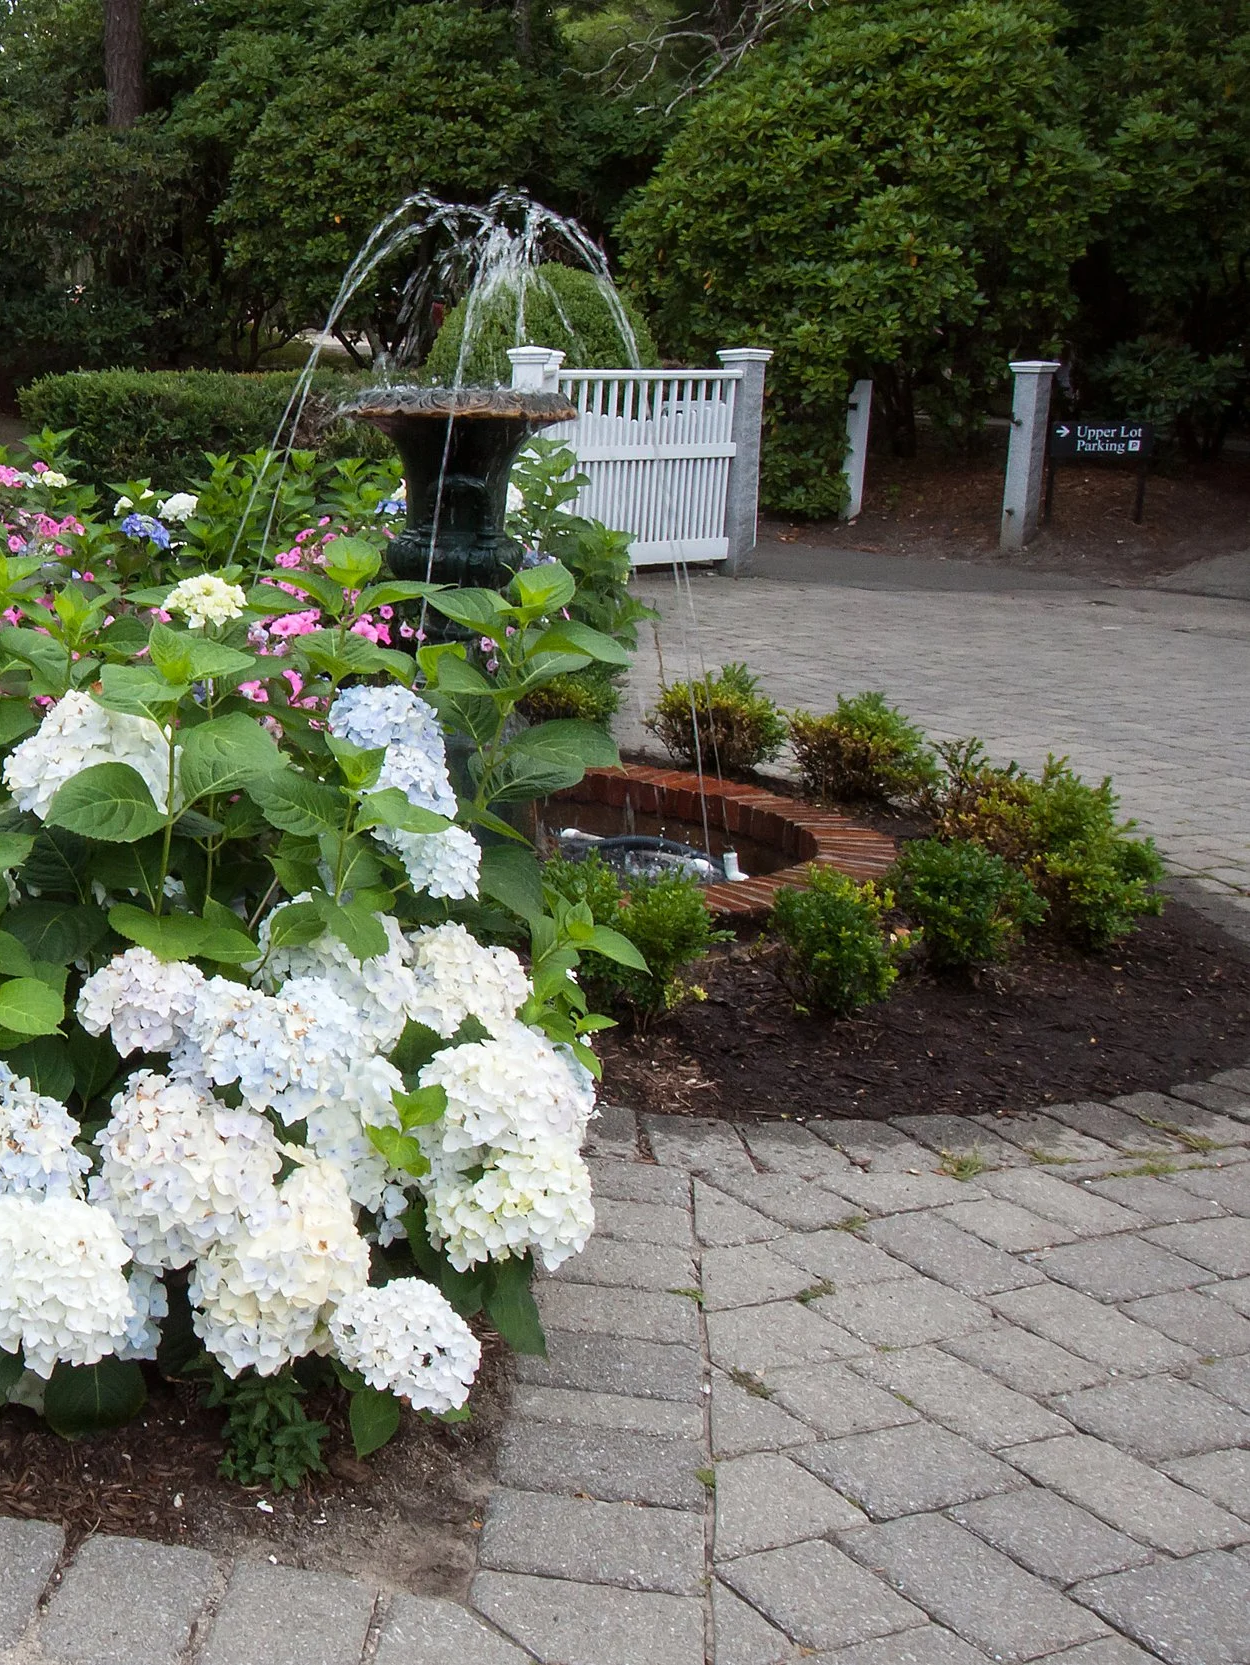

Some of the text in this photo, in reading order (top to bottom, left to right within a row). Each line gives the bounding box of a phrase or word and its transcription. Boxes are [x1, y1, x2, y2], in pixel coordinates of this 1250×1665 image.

[1077, 426, 1142, 440] Upper Lot
[1077, 440, 1125, 454] Parking
